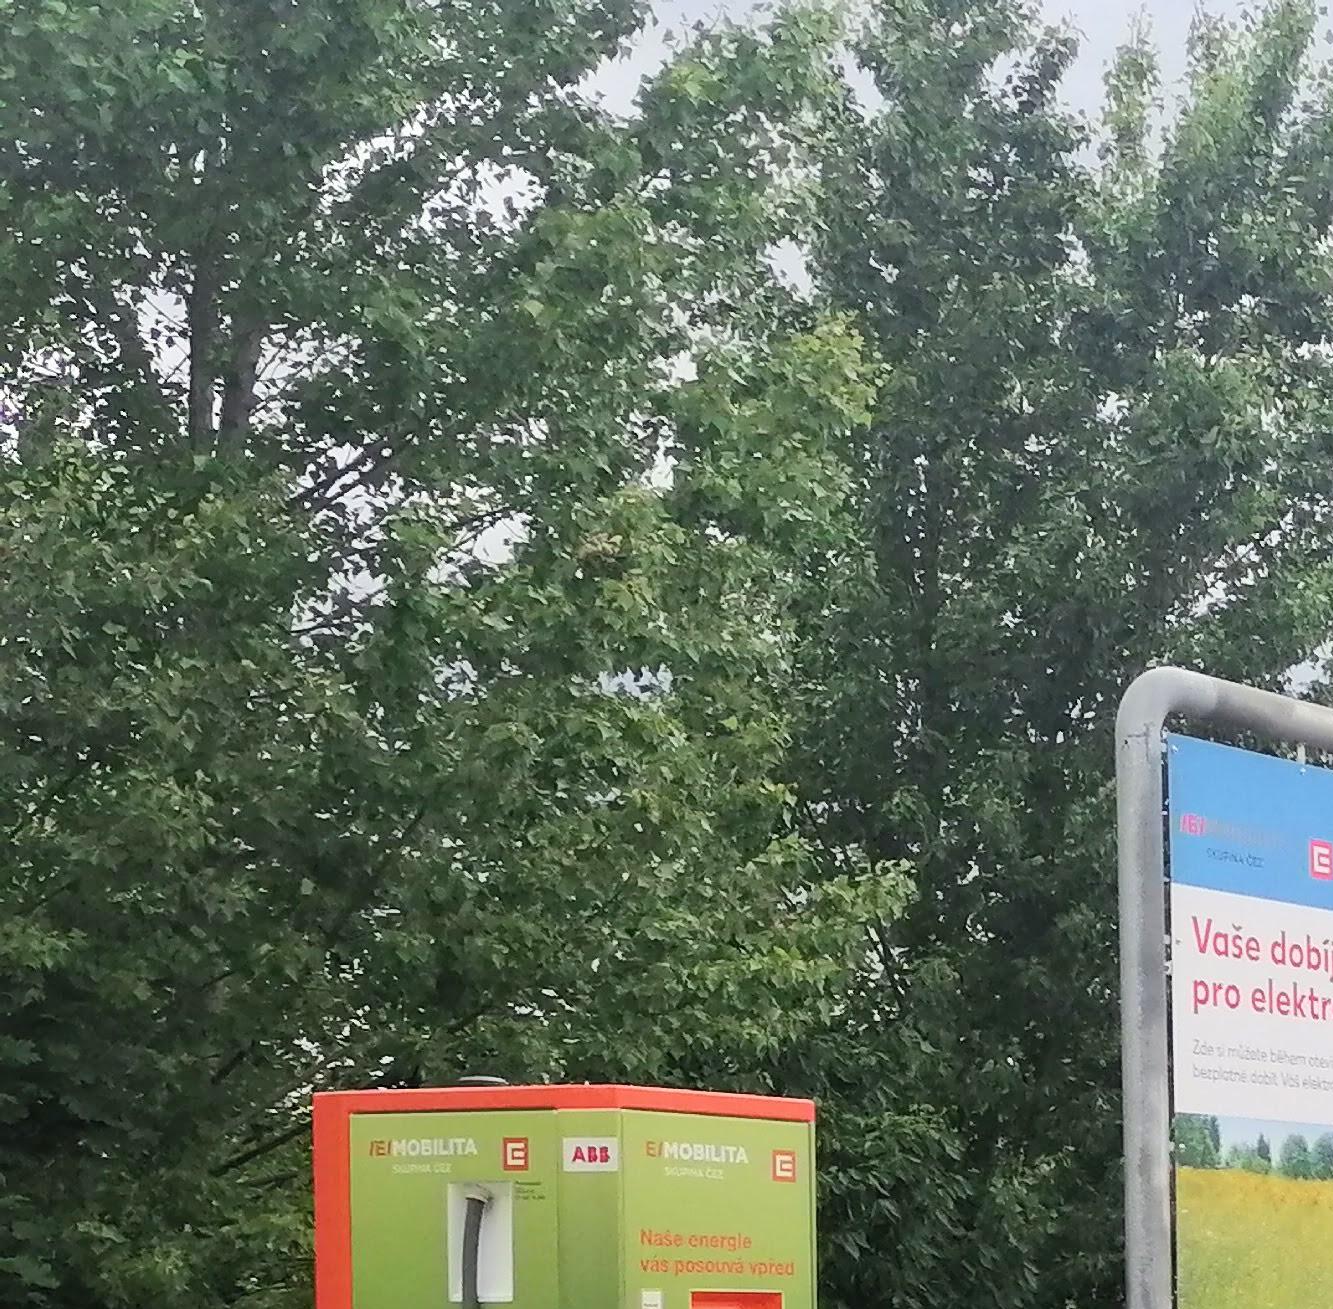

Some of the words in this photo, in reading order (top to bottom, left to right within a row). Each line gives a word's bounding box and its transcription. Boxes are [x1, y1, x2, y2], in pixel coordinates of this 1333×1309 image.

[1191, 915, 1261, 962] Vaše
[1192, 978, 1242, 1015] pro
[572, 1145, 610, 1164] ABB
[639, 1229, 683, 1248] Naše
[687, 1231, 752, 1251] energie
[639, 1254, 668, 1274] vás
[674, 1256, 744, 1278] posouvá
